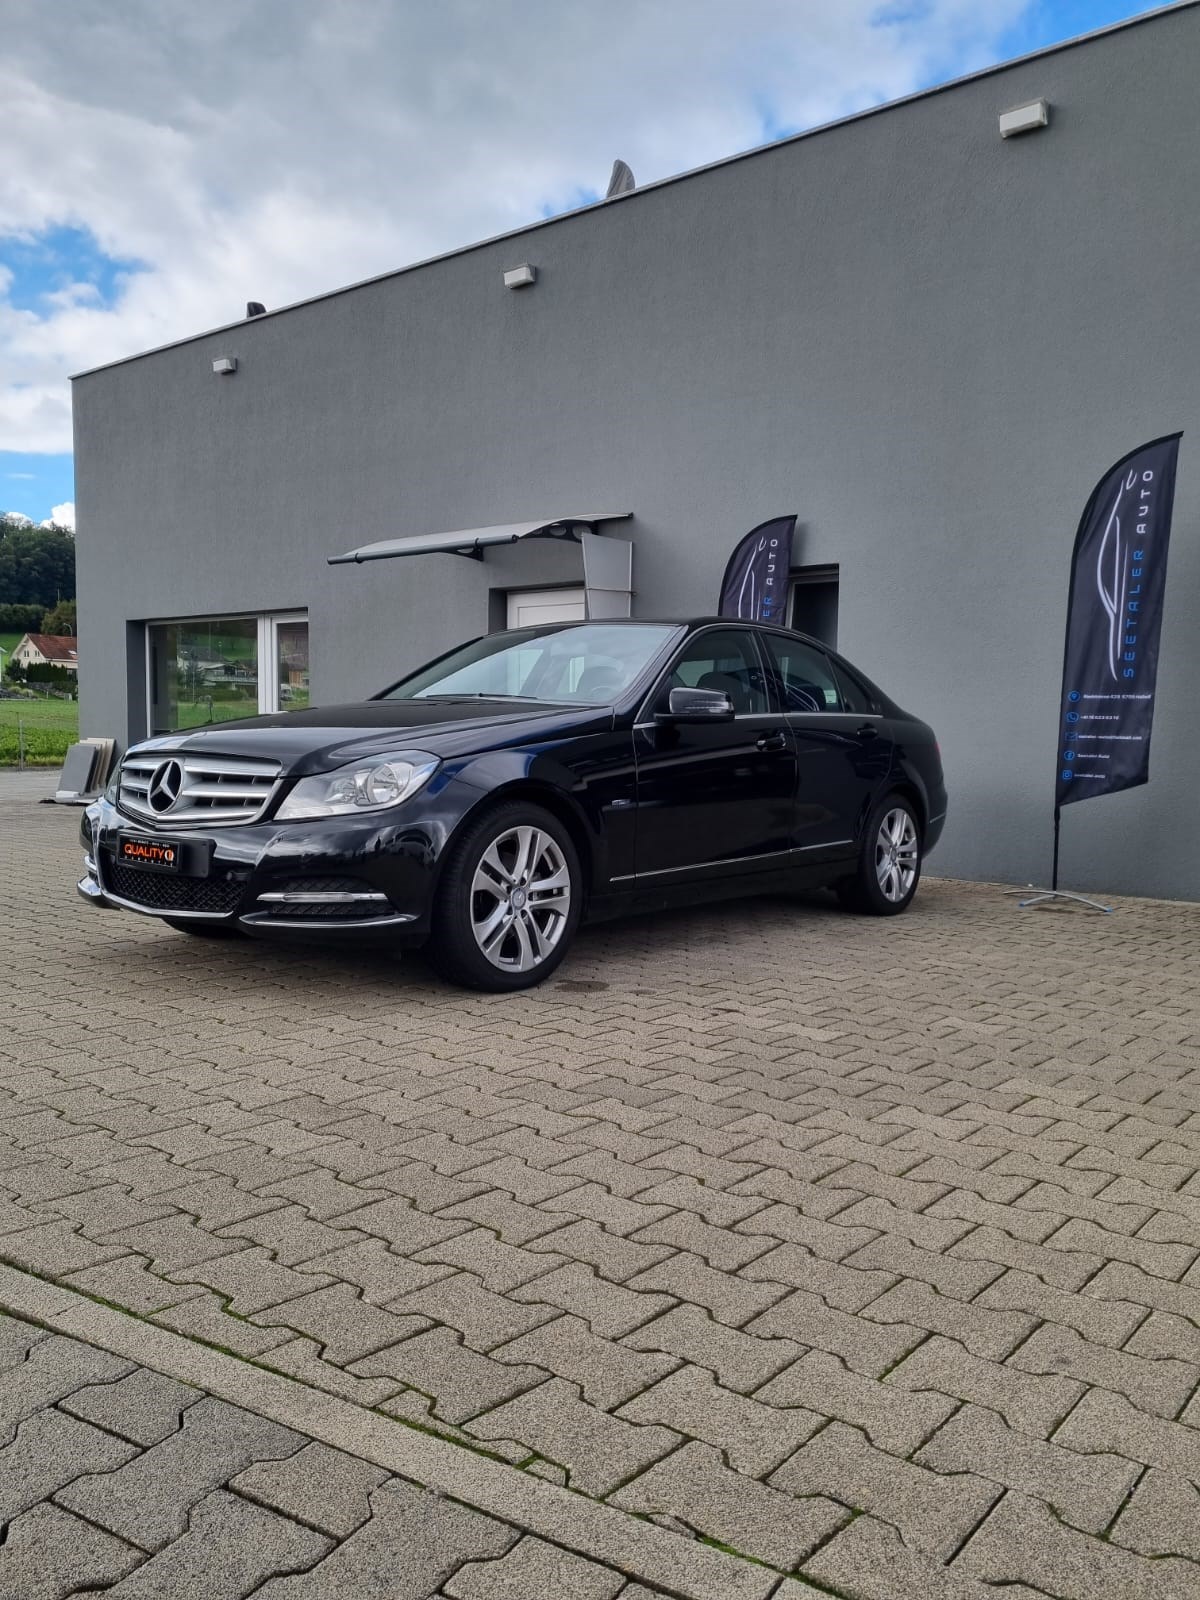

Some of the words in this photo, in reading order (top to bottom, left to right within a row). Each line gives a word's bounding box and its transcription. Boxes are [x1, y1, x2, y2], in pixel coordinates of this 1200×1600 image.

[766, 539, 778, 586] AUTO
[1123, 550, 1144, 677] SEETALER
[1136, 470, 1153, 534] AUTO
